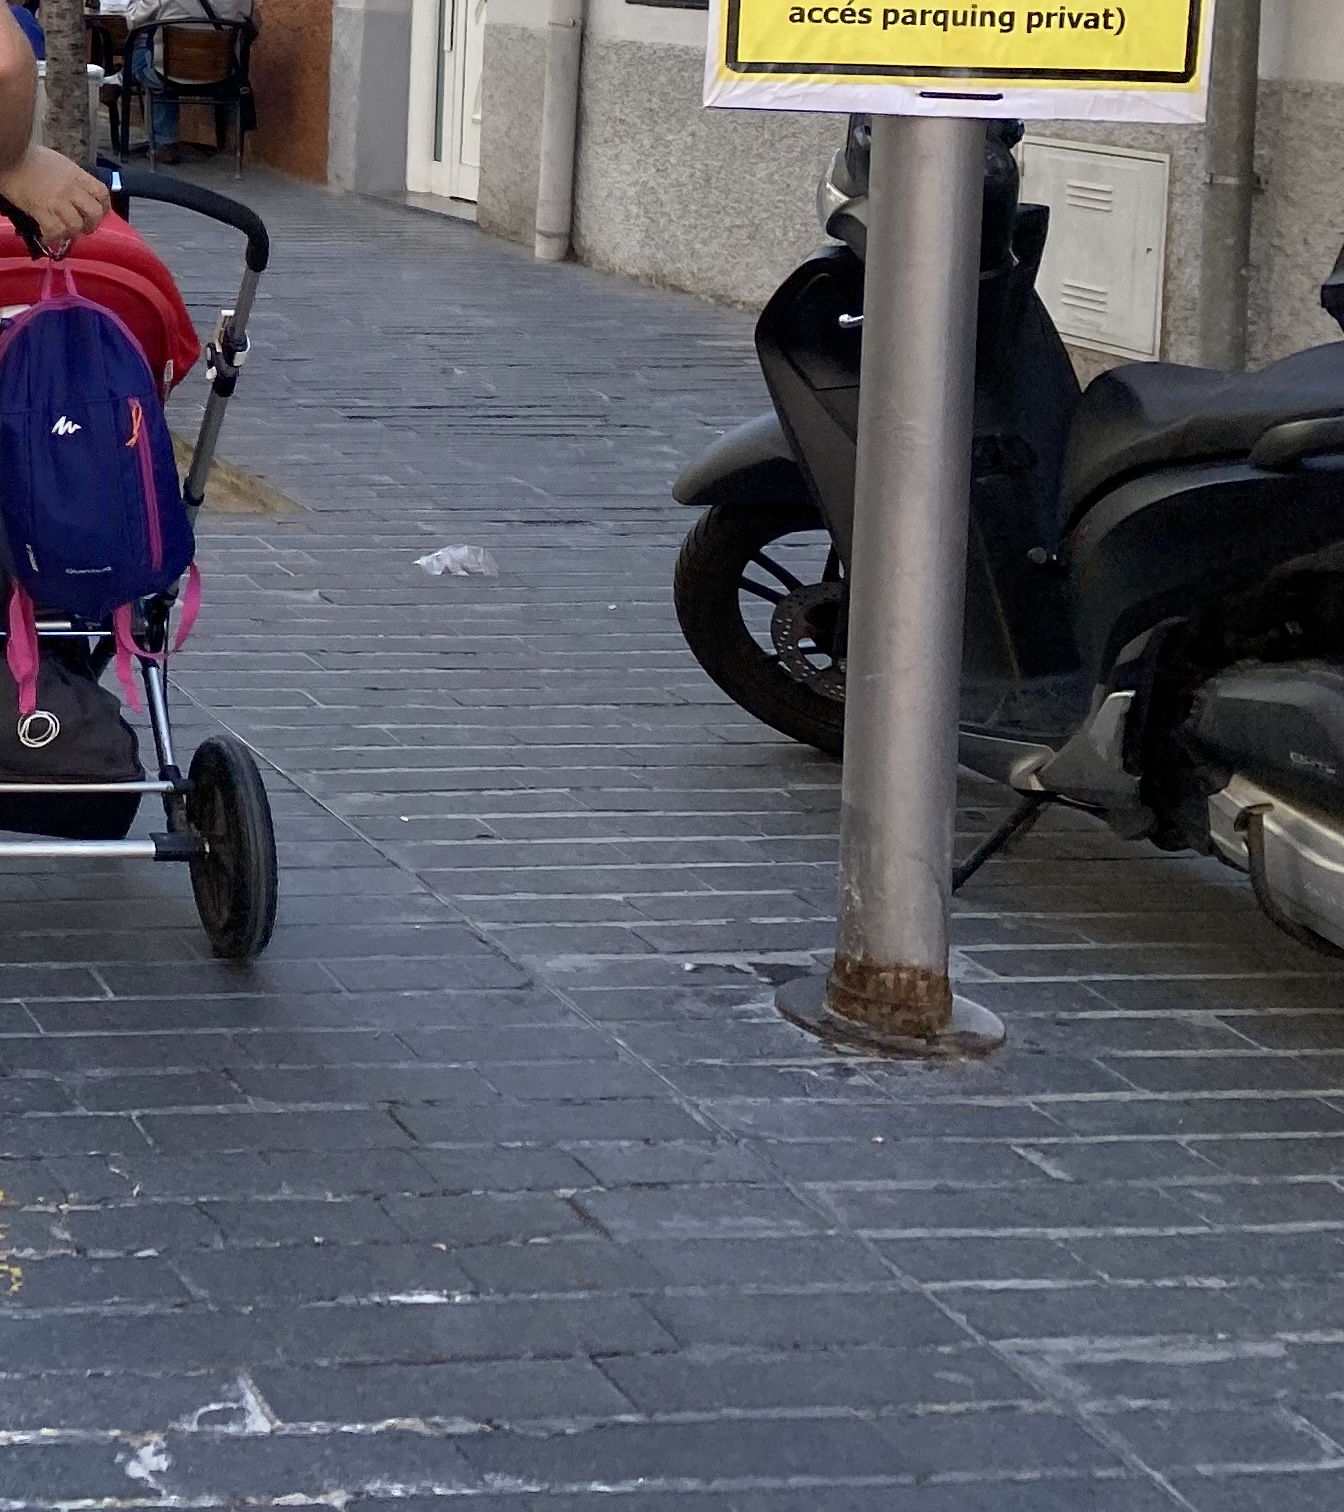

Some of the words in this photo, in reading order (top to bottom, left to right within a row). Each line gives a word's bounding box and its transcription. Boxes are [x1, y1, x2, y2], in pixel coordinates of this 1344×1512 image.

[789, 0, 871, 24] accés
[883, 4, 1015, 33] parquing
[1027, 6, 1125, 35] privat)
